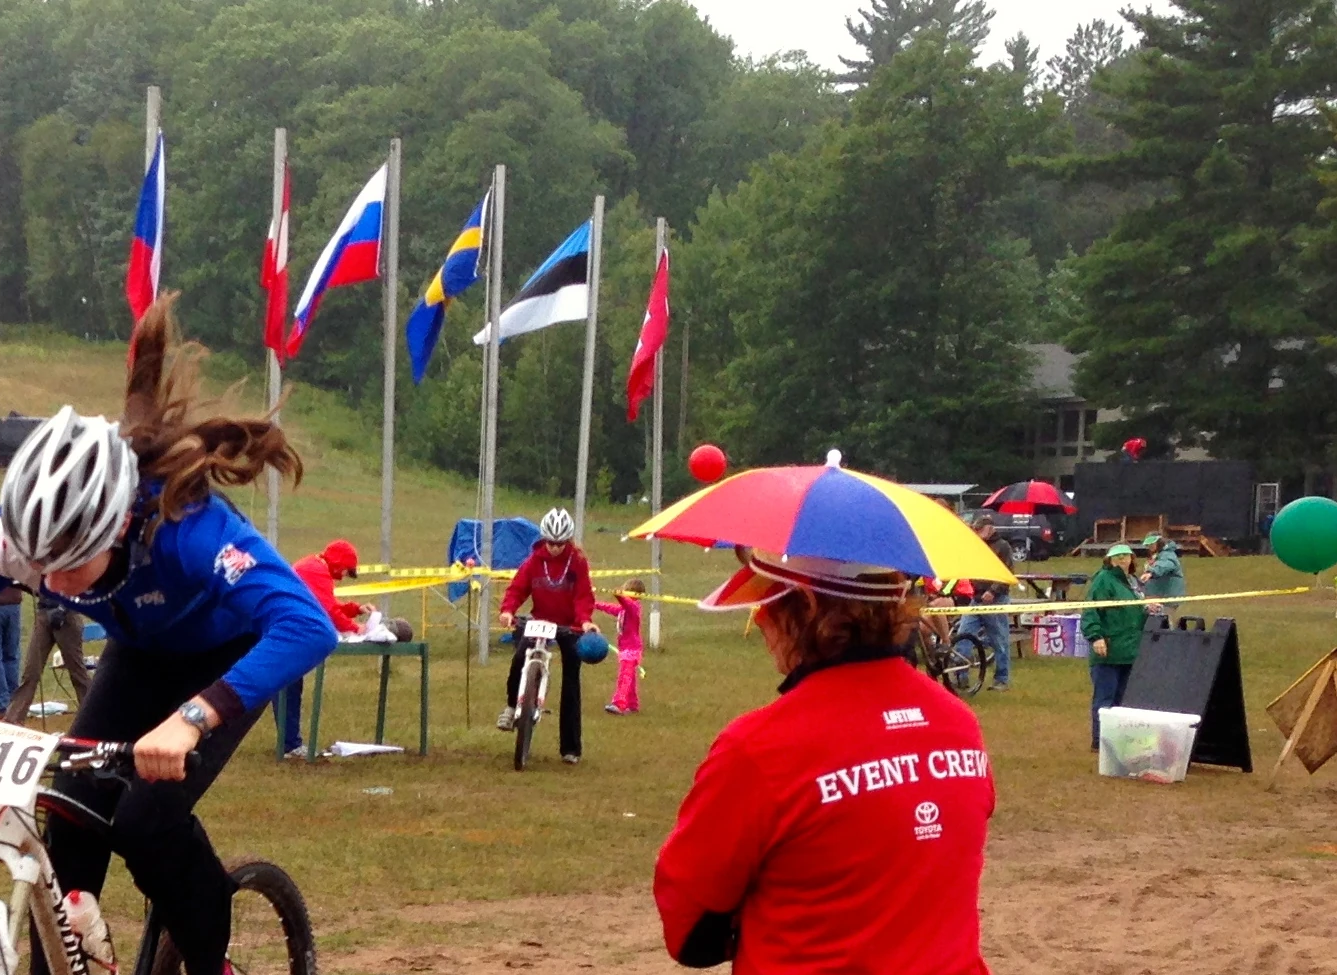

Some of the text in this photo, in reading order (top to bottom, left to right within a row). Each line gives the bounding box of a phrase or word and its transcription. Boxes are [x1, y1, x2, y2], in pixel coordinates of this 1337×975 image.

[816, 749, 988, 804] EVENT CREW
[914, 823, 943, 835] TOYOTA
